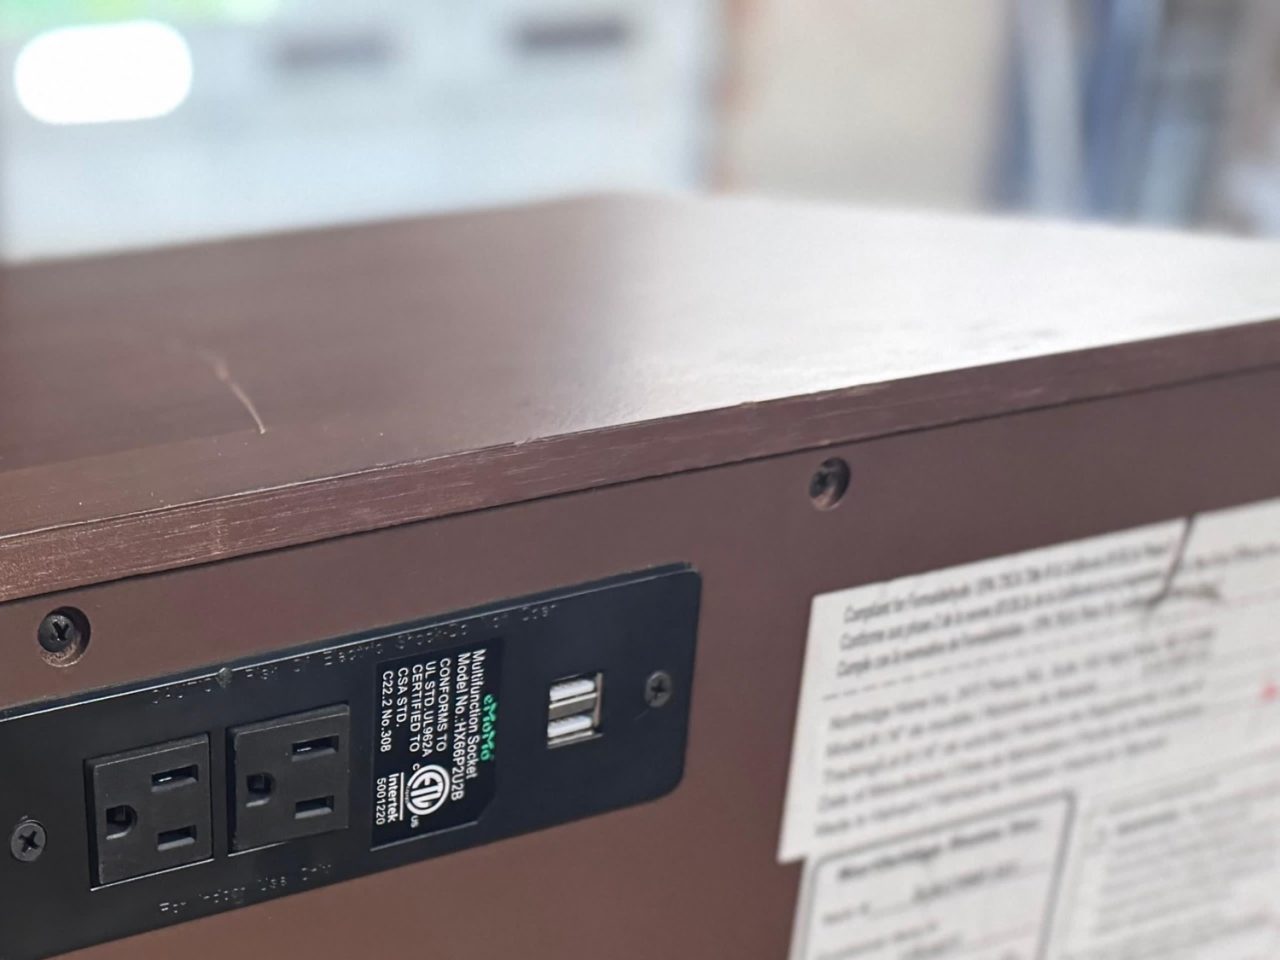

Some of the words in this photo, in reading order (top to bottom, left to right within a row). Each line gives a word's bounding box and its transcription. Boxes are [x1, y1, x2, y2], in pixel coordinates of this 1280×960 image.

[381, 670, 394, 707] C22.2
[397, 667, 409, 695] CSA
[424, 661, 437, 679] UL
[455, 652, 472, 694] Model
[466, 648, 488, 733] Multifunction
[395, 696, 408, 728] STD.
[410, 664, 424, 732] CERTIFIED
[436, 657, 451, 732] CONFORMS
[380, 708, 393, 753] No.308
[409, 733, 421, 752] TO
[435, 733, 448, 752] TO
[480, 694, 498, 761] eMoMo
[465, 734, 480, 779] Socket
[375, 777, 387, 825] 5001220
[387, 772, 400, 823] Intertek
